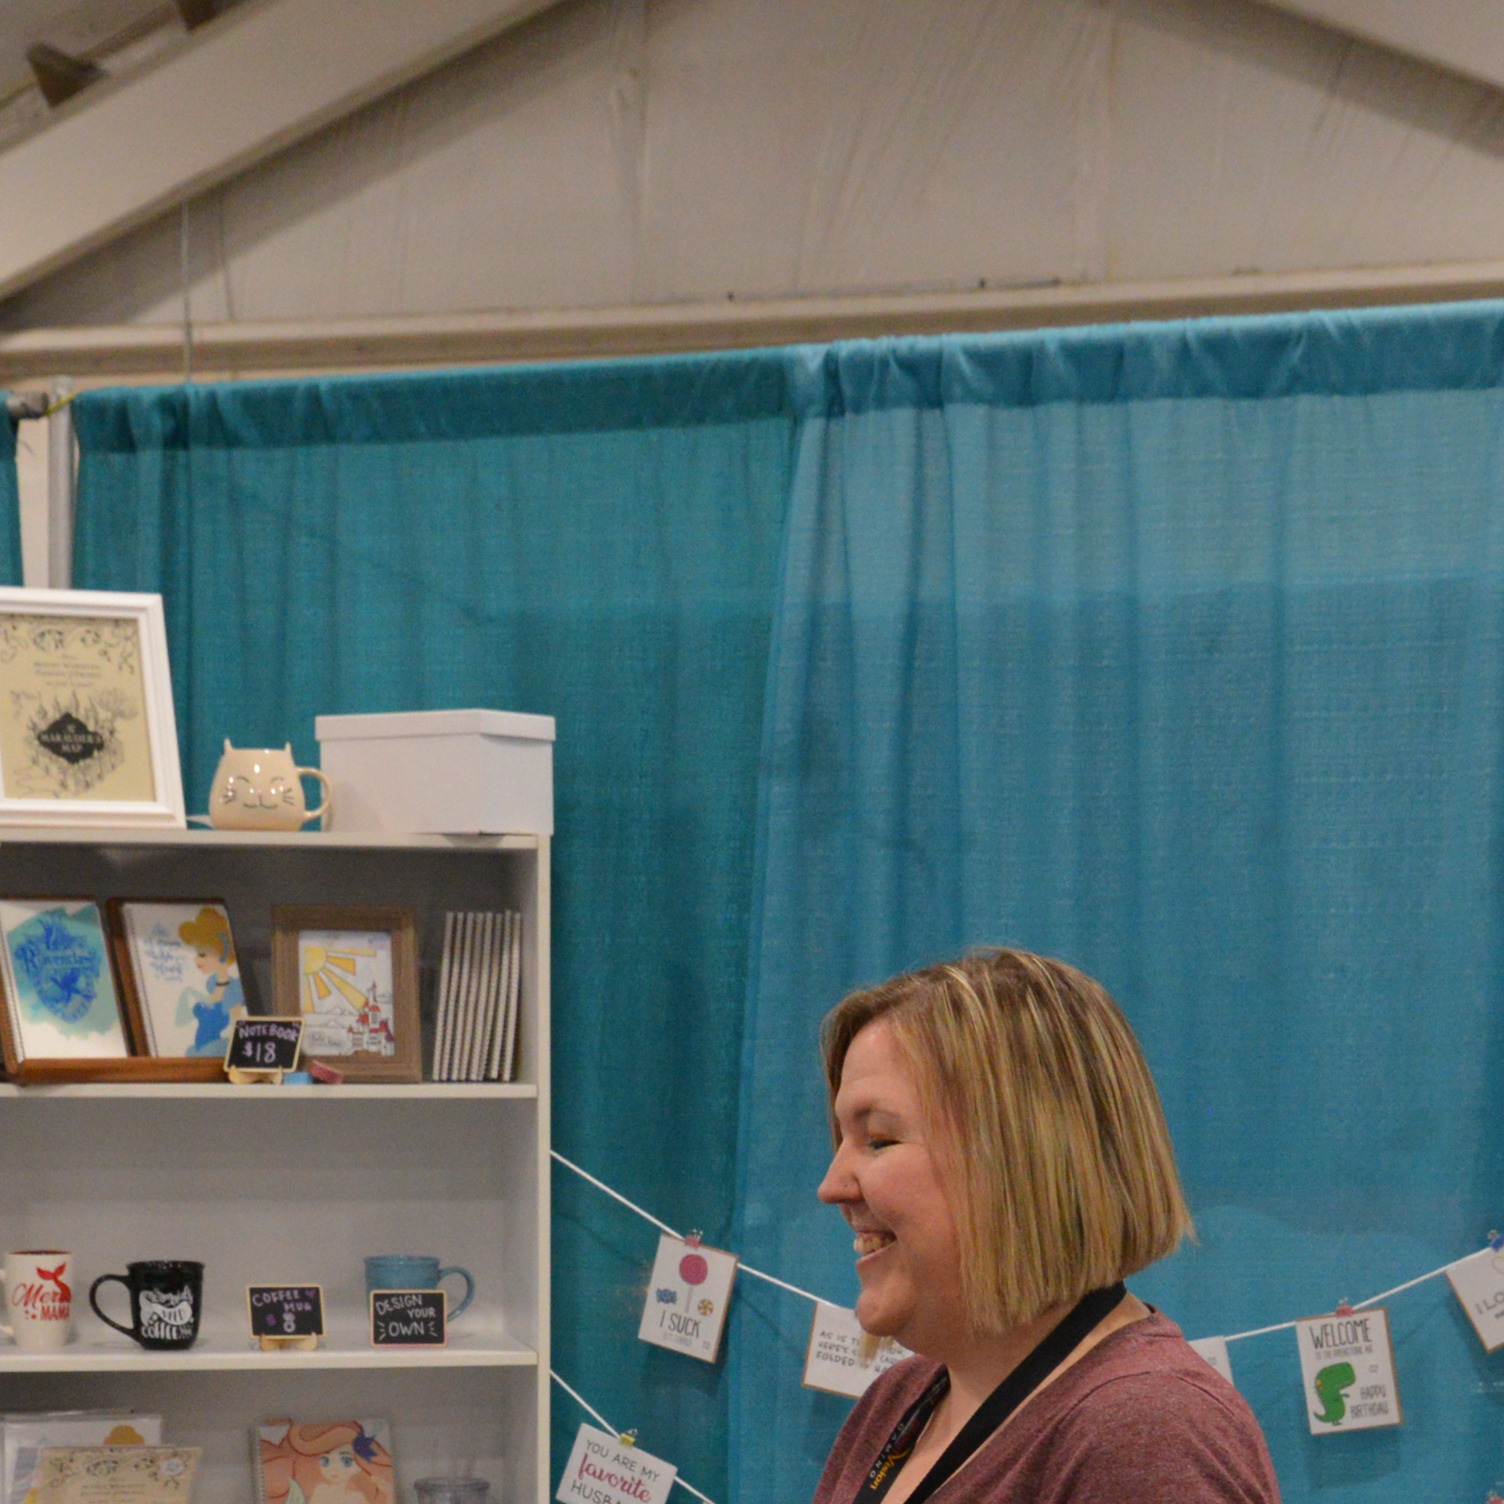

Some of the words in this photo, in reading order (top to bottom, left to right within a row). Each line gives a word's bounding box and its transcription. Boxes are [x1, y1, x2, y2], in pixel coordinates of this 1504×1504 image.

[242, 1041, 277, 1064] $18
[251, 1289, 301, 1308] COFFEE
[375, 1293, 425, 1316] DESIGN
[1474, 1302, 1484, 1316] I
[407, 1306, 437, 1319] YOUR
[659, 1308, 667, 1329] I
[667, 1311, 703, 1340] SUCK
[388, 1321, 426, 1338] OWN
[1308, 1318, 1373, 1350] WELCOME
[815, 1350, 856, 1368] FOLDED
[584, 1437, 611, 1459] YOU
[611, 1450, 640, 1475] ARE
[640, 1463, 662, 1485] MY
[576, 1452, 653, 1504] favorite
